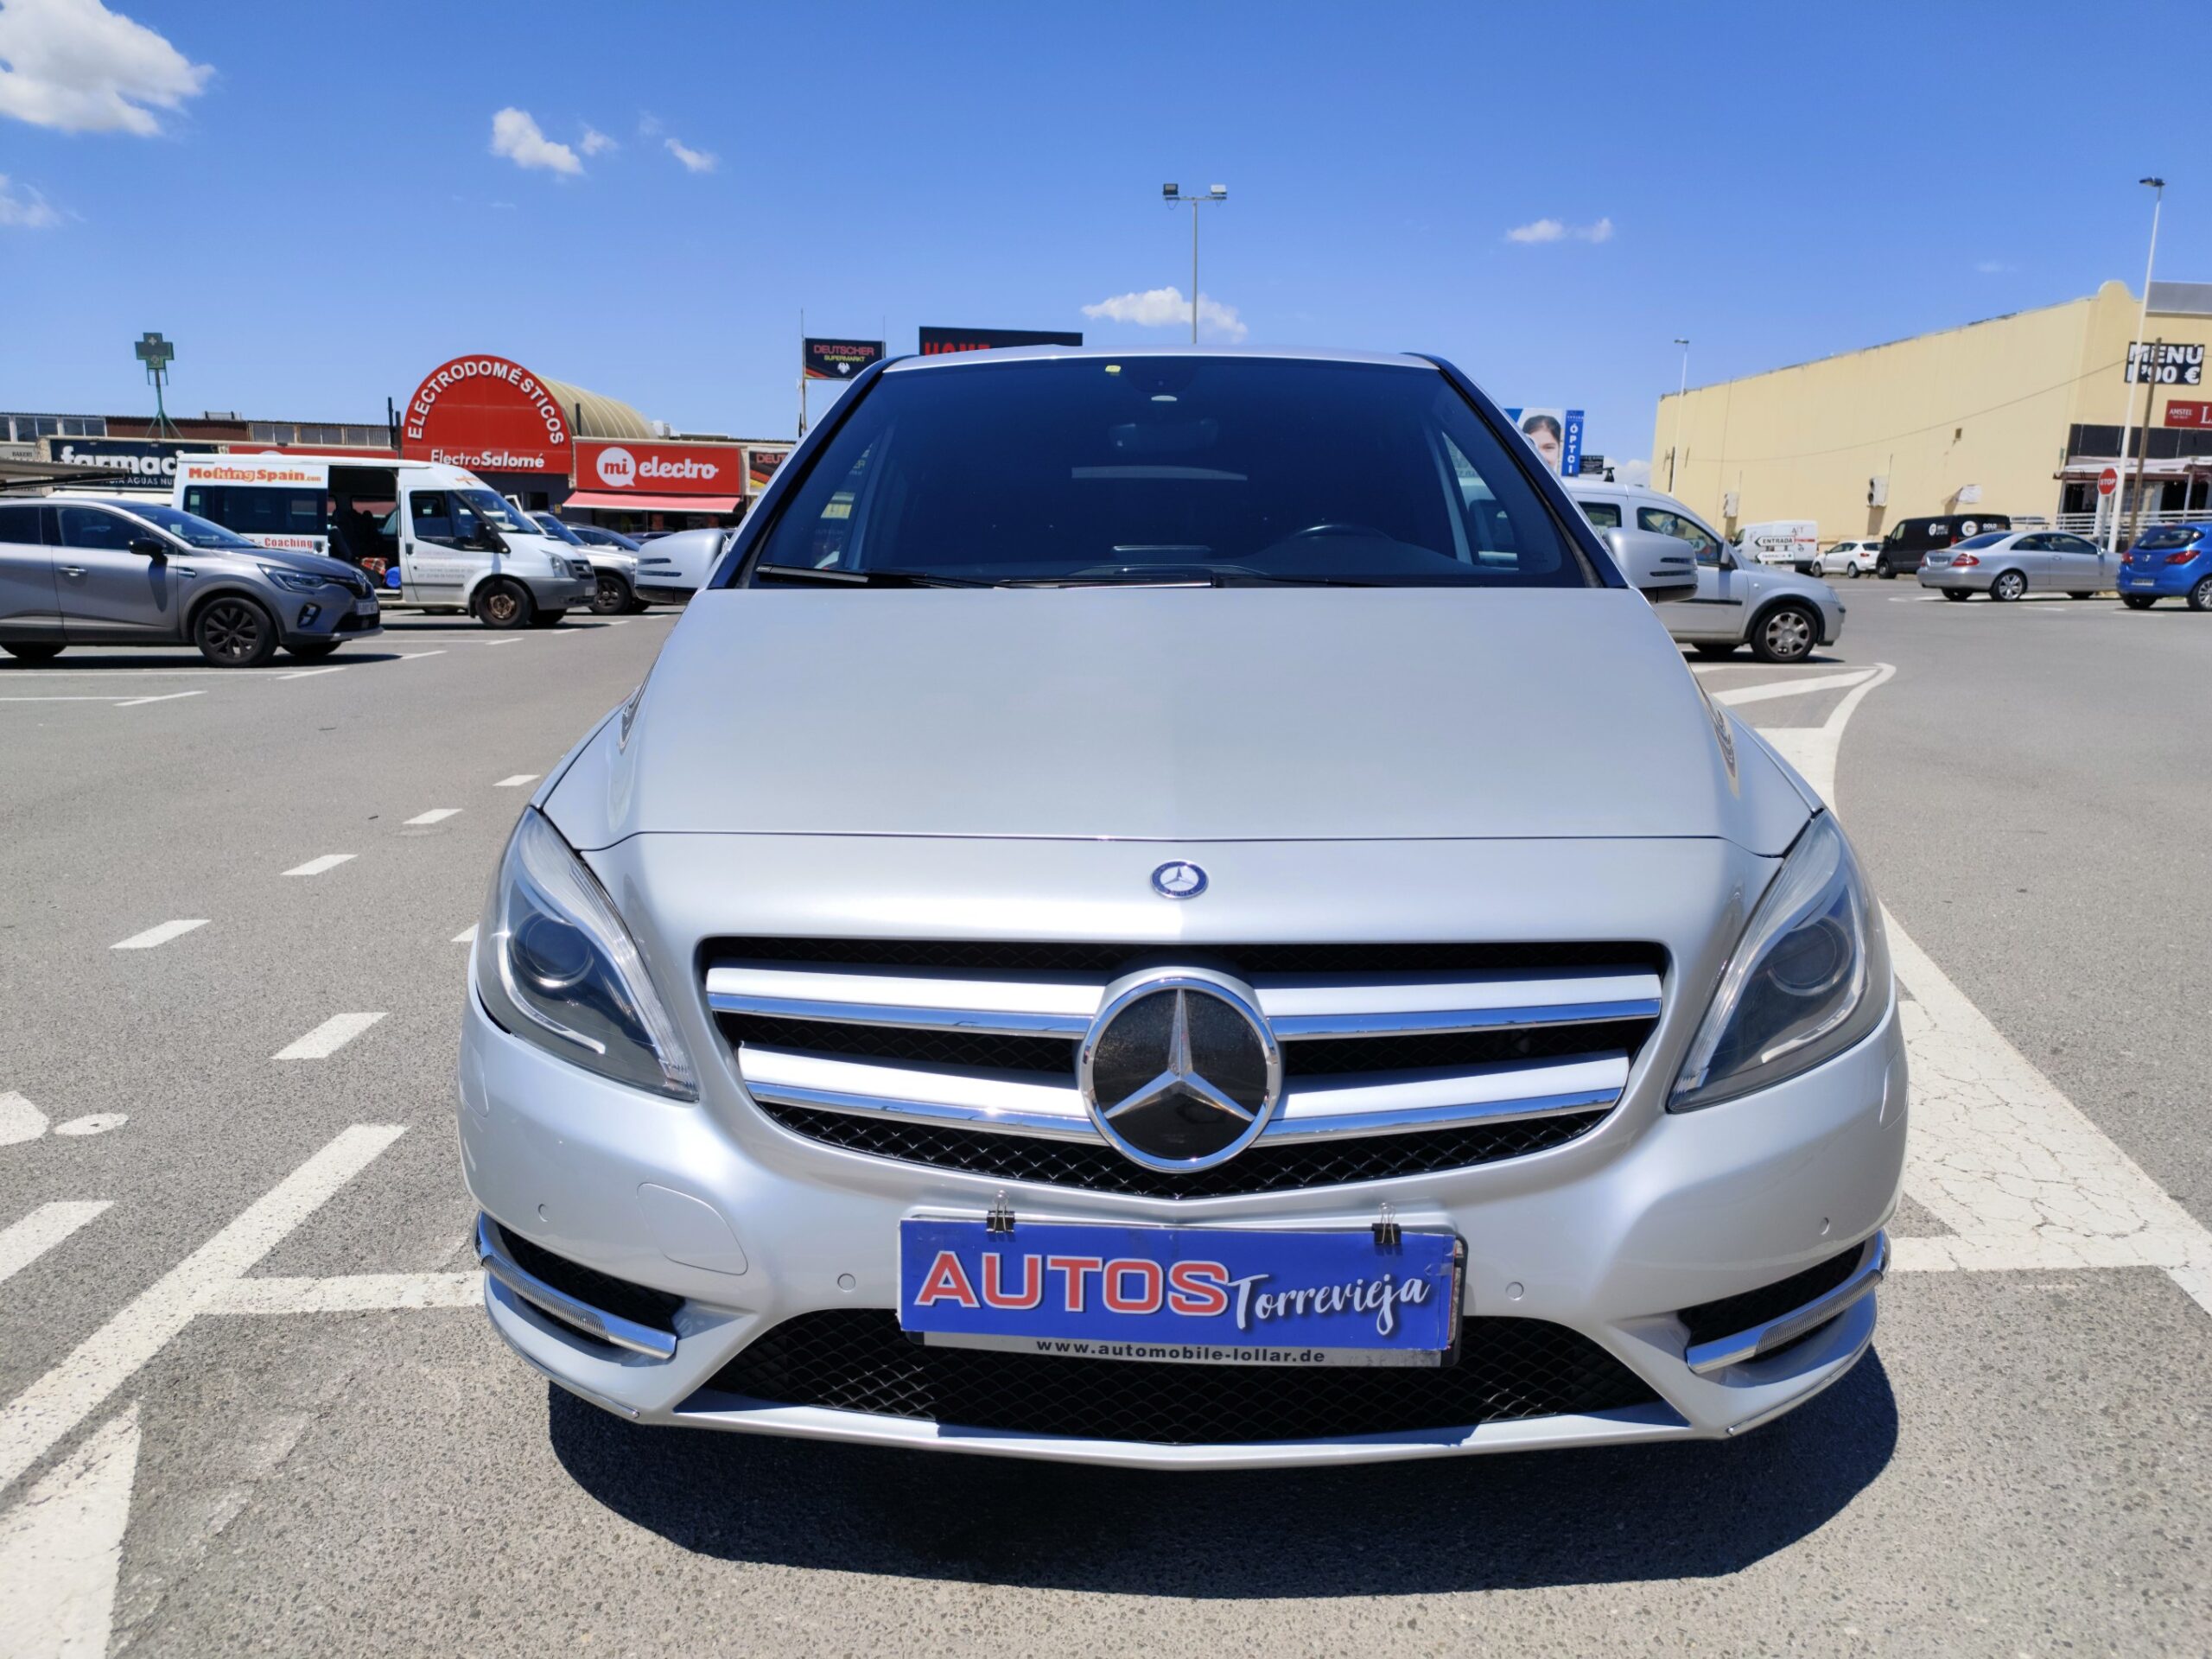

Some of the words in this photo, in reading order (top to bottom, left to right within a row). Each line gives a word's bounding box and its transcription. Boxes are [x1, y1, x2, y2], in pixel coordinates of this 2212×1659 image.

[814, 345, 874, 356] DEUTSCHER
[2128, 344, 2203, 364] MENÚ
[408, 360, 564, 444] ELECTRODOMÉSTICOS
[2200, 405, 2212, 423] L
[431, 449, 545, 468] ElectroSalomé
[605, 458, 630, 475] mi
[639, 456, 719, 480] electro
[264, 537, 313, 549] Coaching
[913, 1250, 1228, 1316] AUTOS
[1227, 1274, 1431, 1335] Torrevieja
[1036, 1340, 1325, 1363] www.automobile-lollar.de
